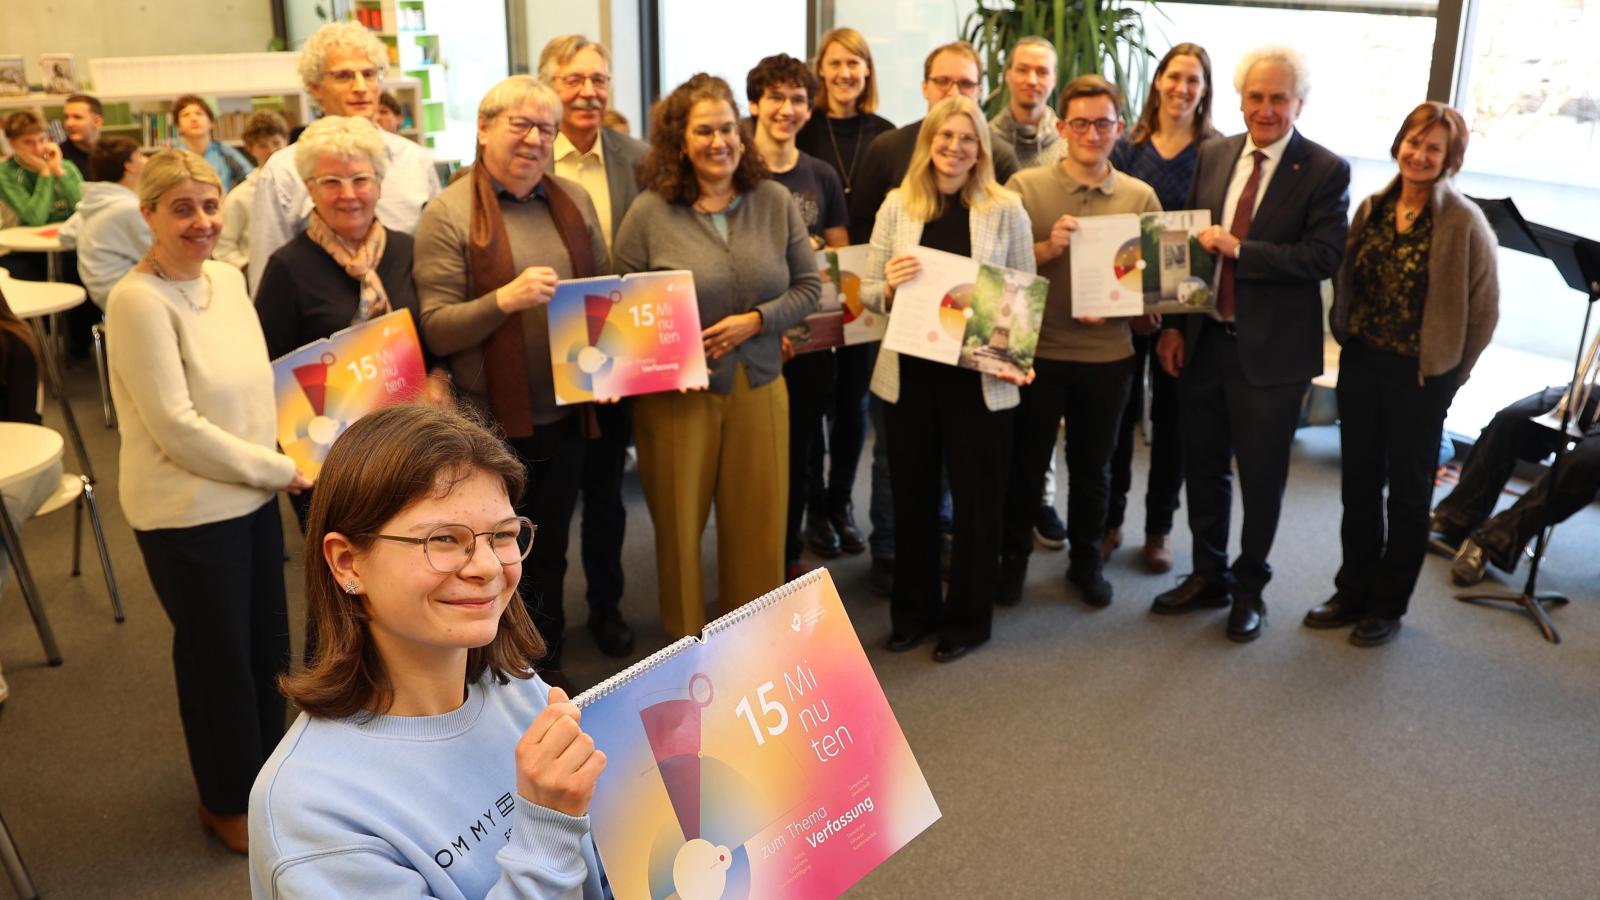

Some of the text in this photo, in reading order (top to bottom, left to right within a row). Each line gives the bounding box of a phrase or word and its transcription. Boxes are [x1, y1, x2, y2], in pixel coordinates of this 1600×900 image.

[628, 303, 673, 328] 15 Mi
[657, 319, 674, 331] nu
[658, 331, 680, 345] ten
[346, 354, 378, 384] 15
[735, 659, 818, 746] 15 Mi
[799, 698, 830, 733] nu
[811, 725, 853, 762] ten
[434, 808, 496, 869] OMMY
[760, 834, 786, 860] zum
[785, 805, 827, 840] Thema
[805, 795, 875, 849] Verfassung
